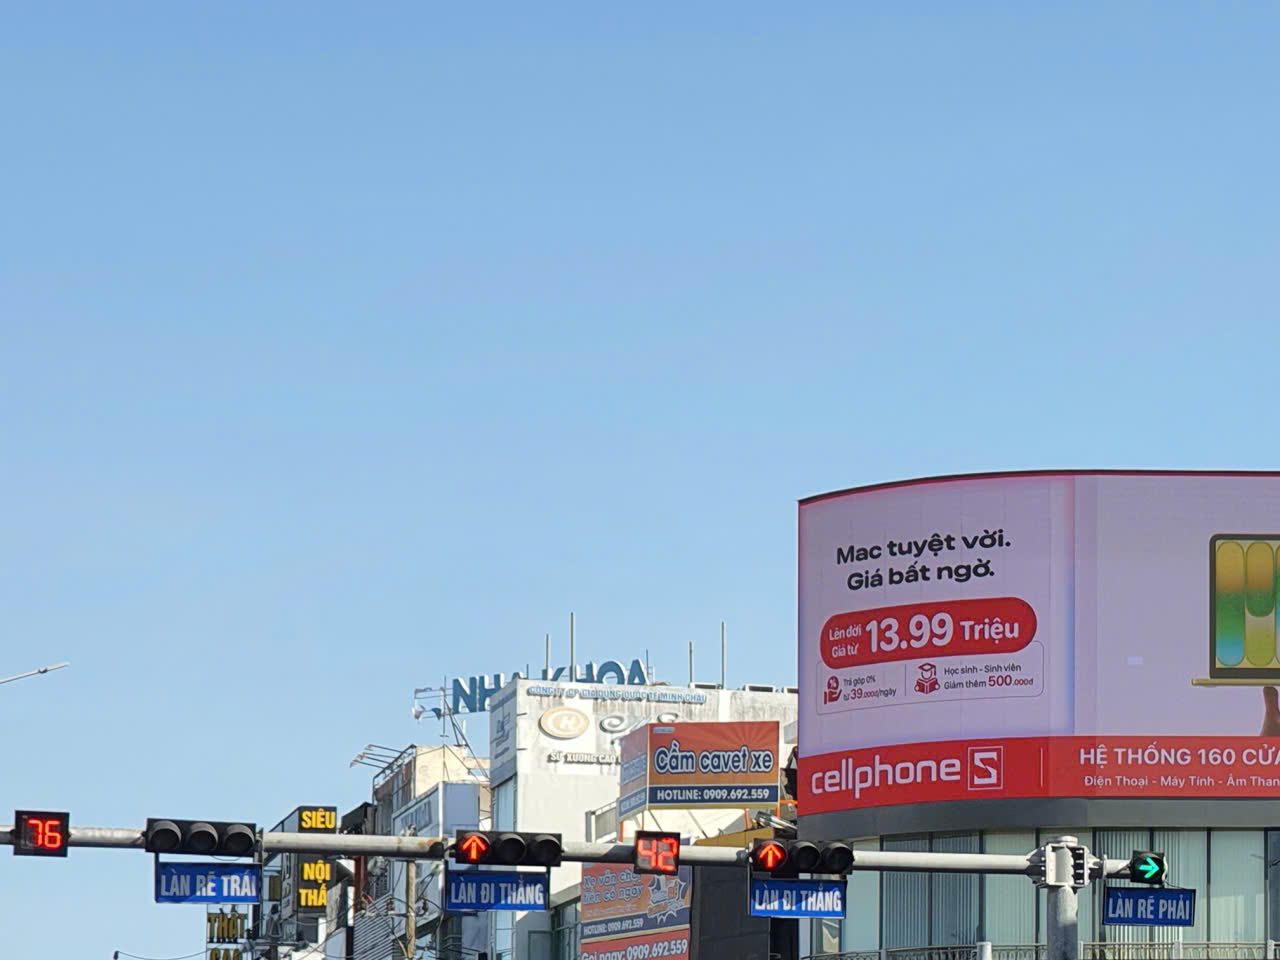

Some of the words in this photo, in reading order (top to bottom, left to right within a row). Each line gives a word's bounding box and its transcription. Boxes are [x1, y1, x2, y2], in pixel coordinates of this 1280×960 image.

[836, 544, 882, 565] Mac
[887, 532, 956, 560] tuyệt
[961, 529, 1011, 550] vời.
[847, 570, 883, 590] Giá
[888, 560, 930, 587] bất
[936, 557, 995, 583] ngờ.
[866, 612, 954, 653] 13.99
[960, 617, 1020, 644] Triệu
[944, 667, 960, 676] Học
[961, 665, 978, 674] sinh
[984, 664, 1002, 673] Sinh
[1003, 663, 1021, 672] viên
[965, 679, 987, 688] thêm
[452, 671, 521, 715] NH
[655, 739, 696, 774] Cầm
[699, 745, 748, 773] cavet
[750, 749, 774, 773] xe
[1079, 744, 1108, 769] HỆ
[1114, 741, 1191, 765] THỐNG
[1197, 748, 1235, 765] 160
[657, 789, 701, 800] HOTLINE:
[703, 789, 770, 800] 0909.692.559
[1084, 775, 1111, 788] Điện
[1115, 775, 1148, 789] Thoại
[1160, 775, 1185, 788] Máy
[1189, 775, 1214, 786] Tính
[301, 808, 336, 829] SIÊU
[28, 819, 62, 849] 76
[638, 837, 679, 871] 42
[160, 868, 191, 896] LÀN
[221, 869, 257, 897] TRÁI
[303, 860, 331, 884] NỘI
[299, 884, 327, 907] THẤ
[450, 877, 477, 904] LÀN
[480, 883, 495, 904] ĐI
[755, 882, 779, 911] LÀN
[782, 889, 798, 912] ĐI
[1108, 892, 1134, 918] LÀN
[1158, 894, 1190, 920] PHẢI
